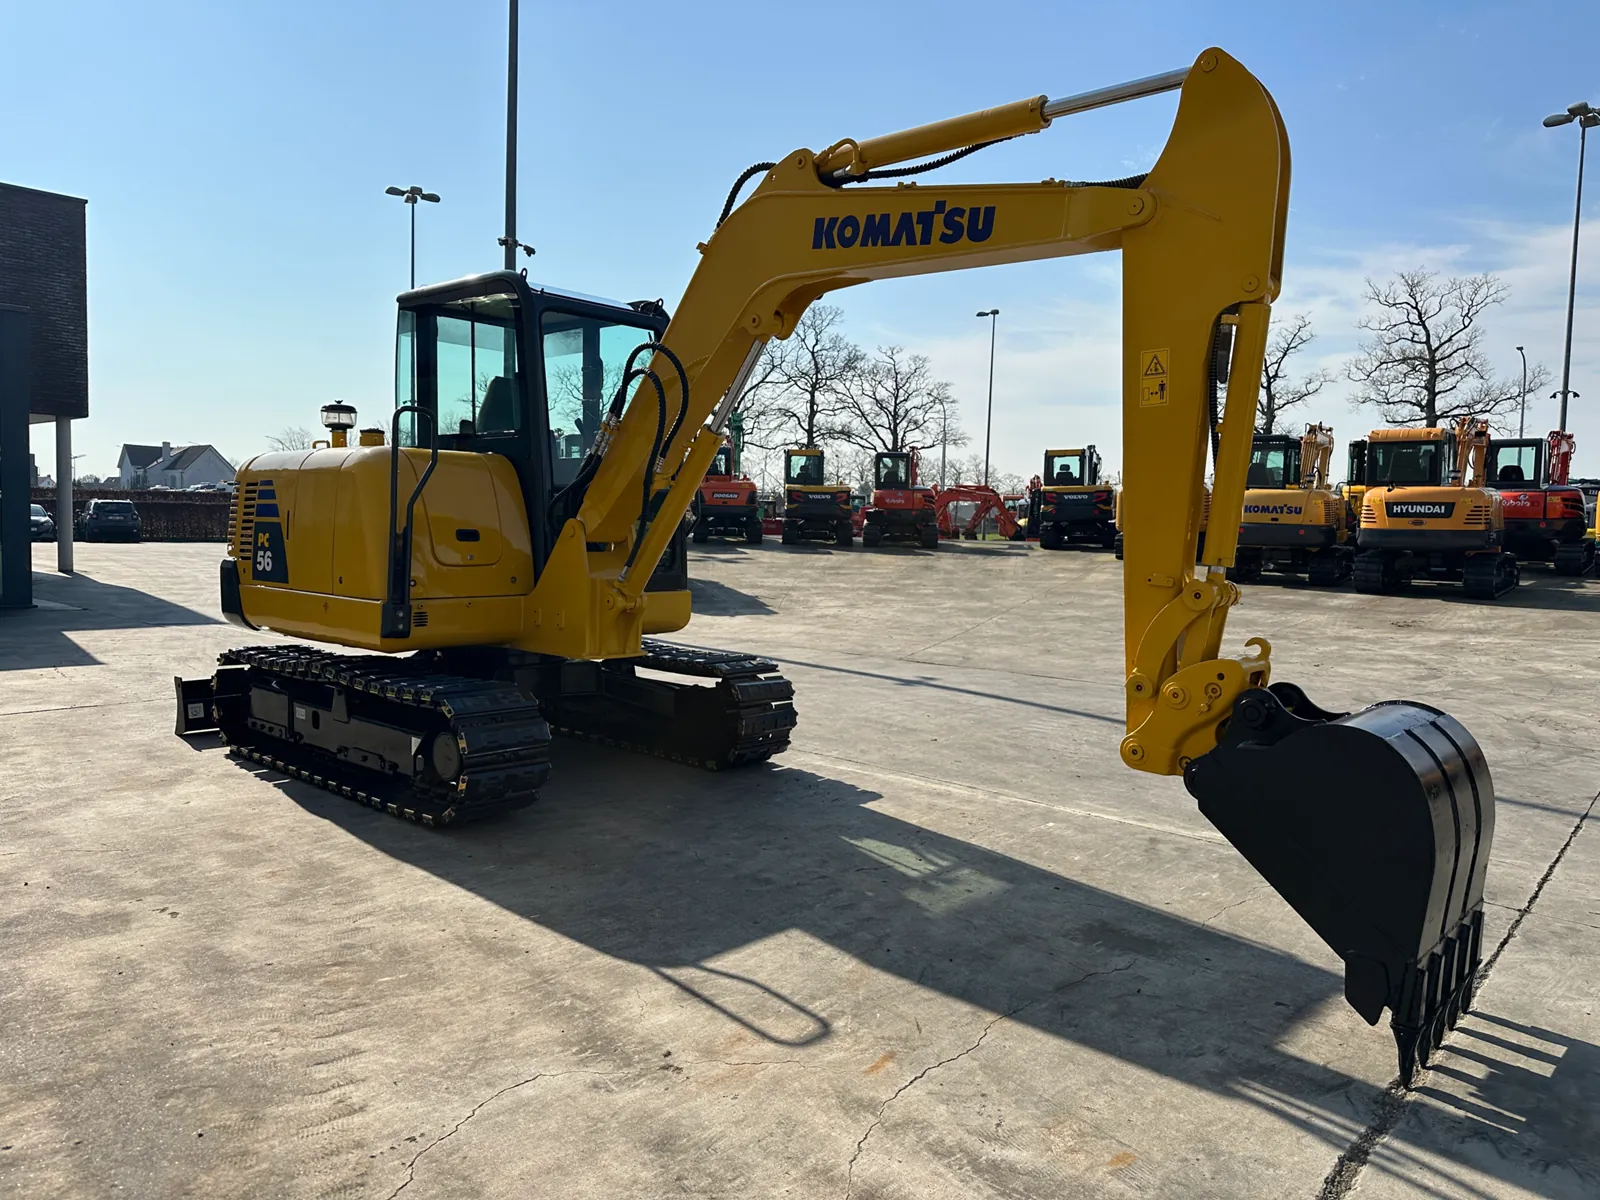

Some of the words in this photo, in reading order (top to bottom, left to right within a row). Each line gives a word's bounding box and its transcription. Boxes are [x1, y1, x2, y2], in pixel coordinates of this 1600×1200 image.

[812, 200, 996, 250] KOMATSU
[1244, 504, 1302, 514] KOMATSU
[1393, 505, 1445, 513] HYUNDAI
[258, 532, 270, 548] PC
[256, 550, 272, 571] 56
